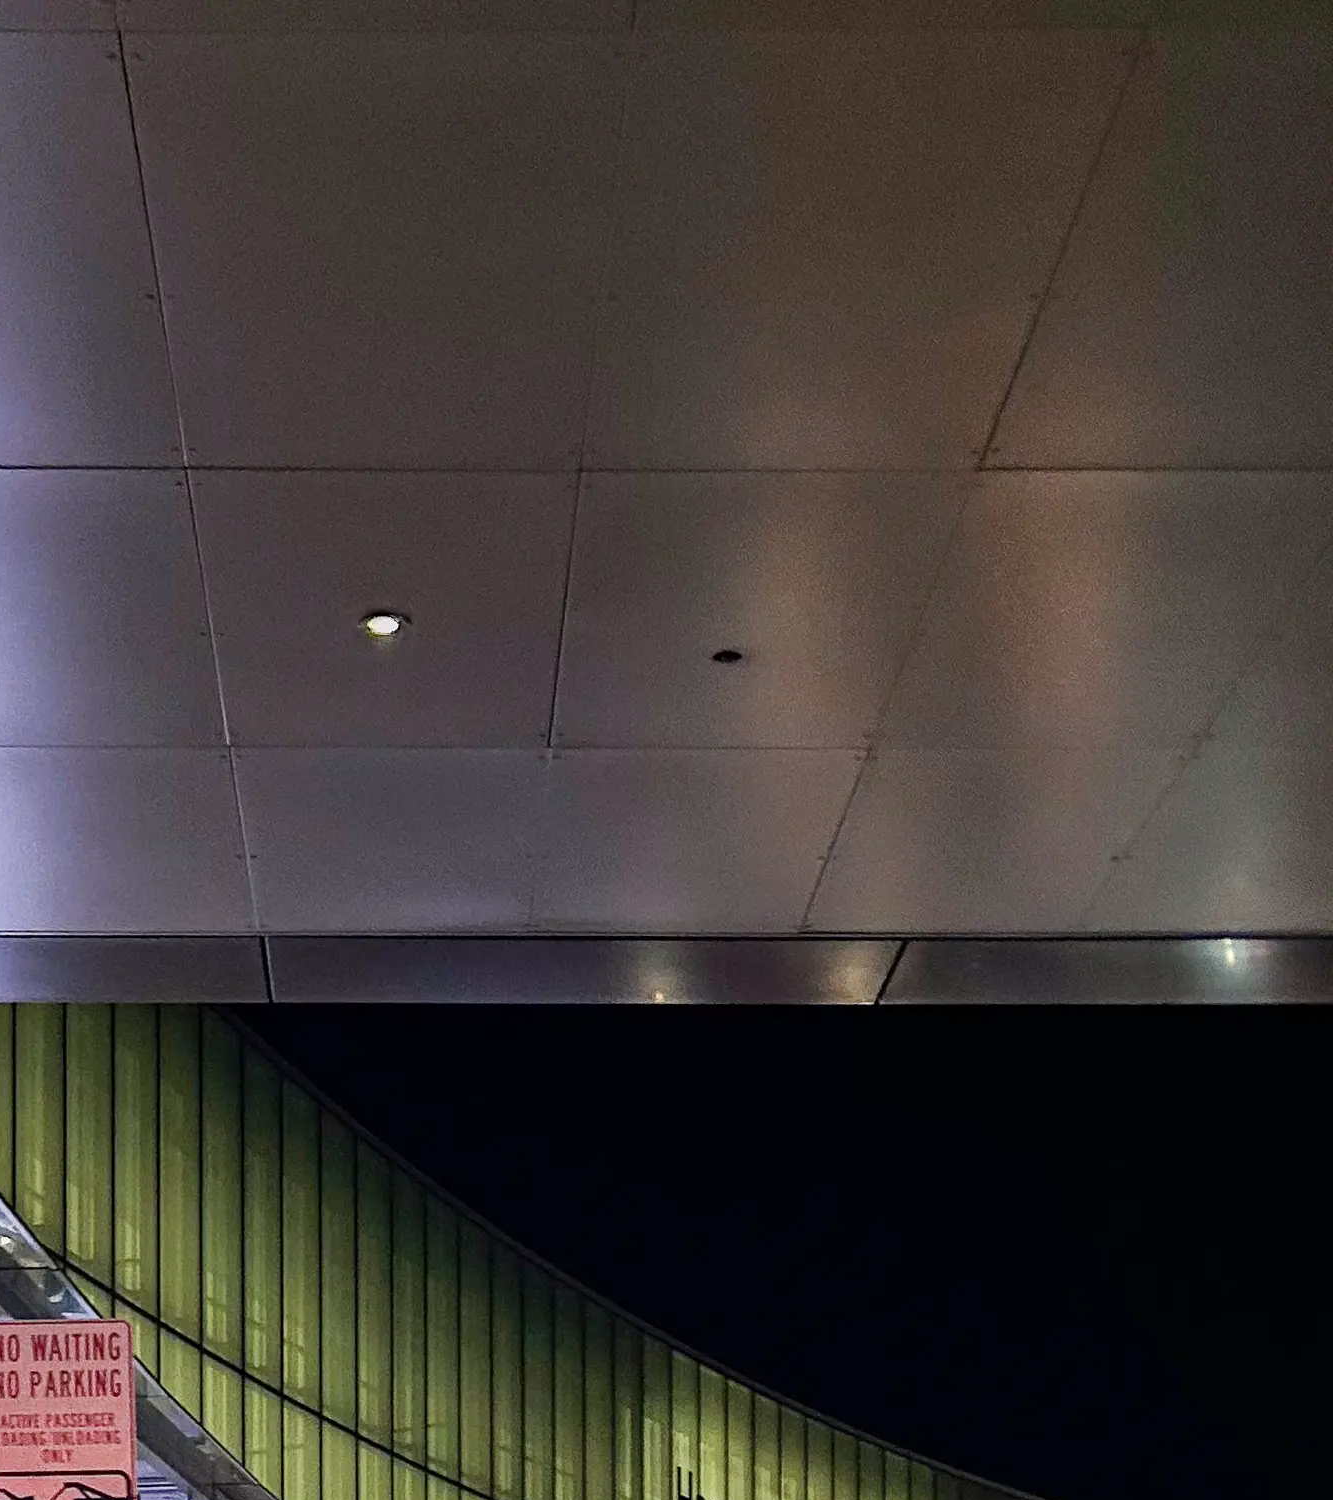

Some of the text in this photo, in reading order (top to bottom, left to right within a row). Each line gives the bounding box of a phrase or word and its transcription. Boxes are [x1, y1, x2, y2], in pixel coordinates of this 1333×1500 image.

[31, 1332, 121, 1361] WAITING
[30, 1369, 121, 1398] PARKING
[45, 1412, 115, 1428] PASSENGER
